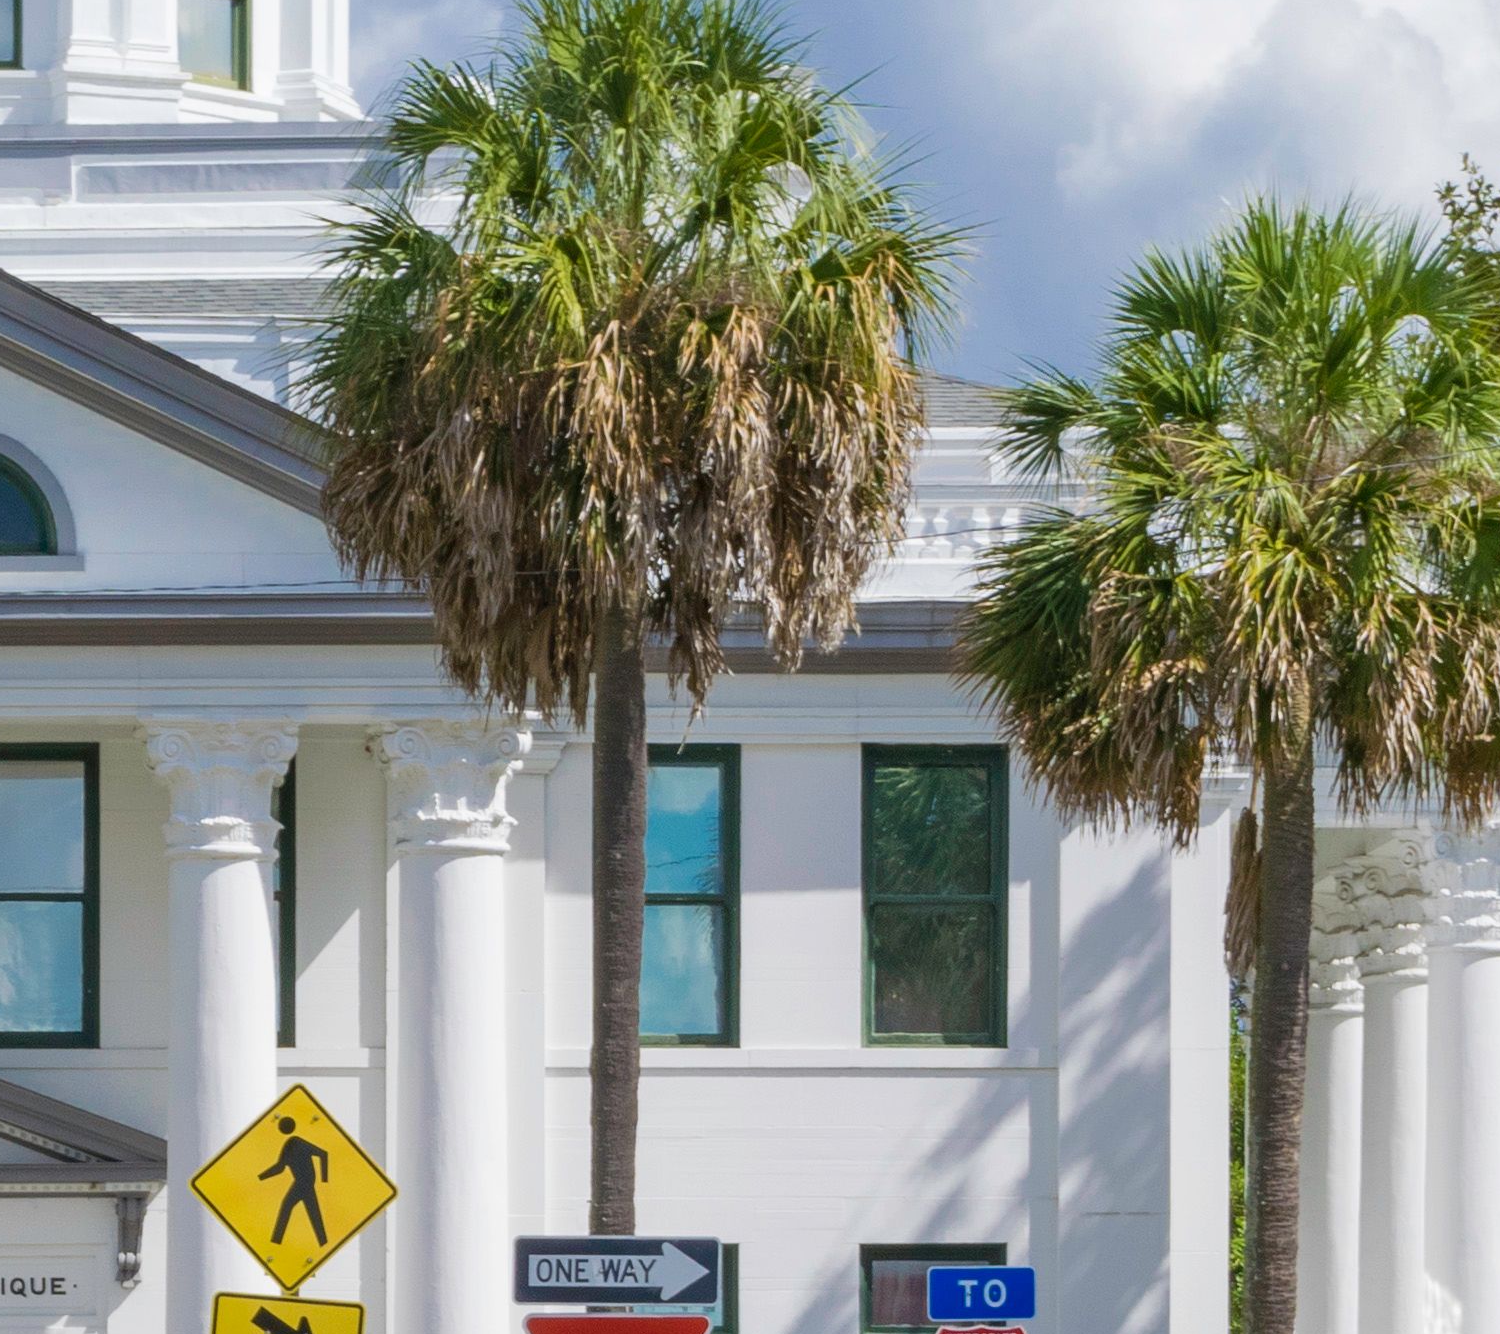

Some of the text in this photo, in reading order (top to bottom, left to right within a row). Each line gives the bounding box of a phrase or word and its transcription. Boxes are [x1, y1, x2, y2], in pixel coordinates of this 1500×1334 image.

[536, 1259, 656, 1283] ONE WAY
[957, 1279, 1007, 1308] TO
